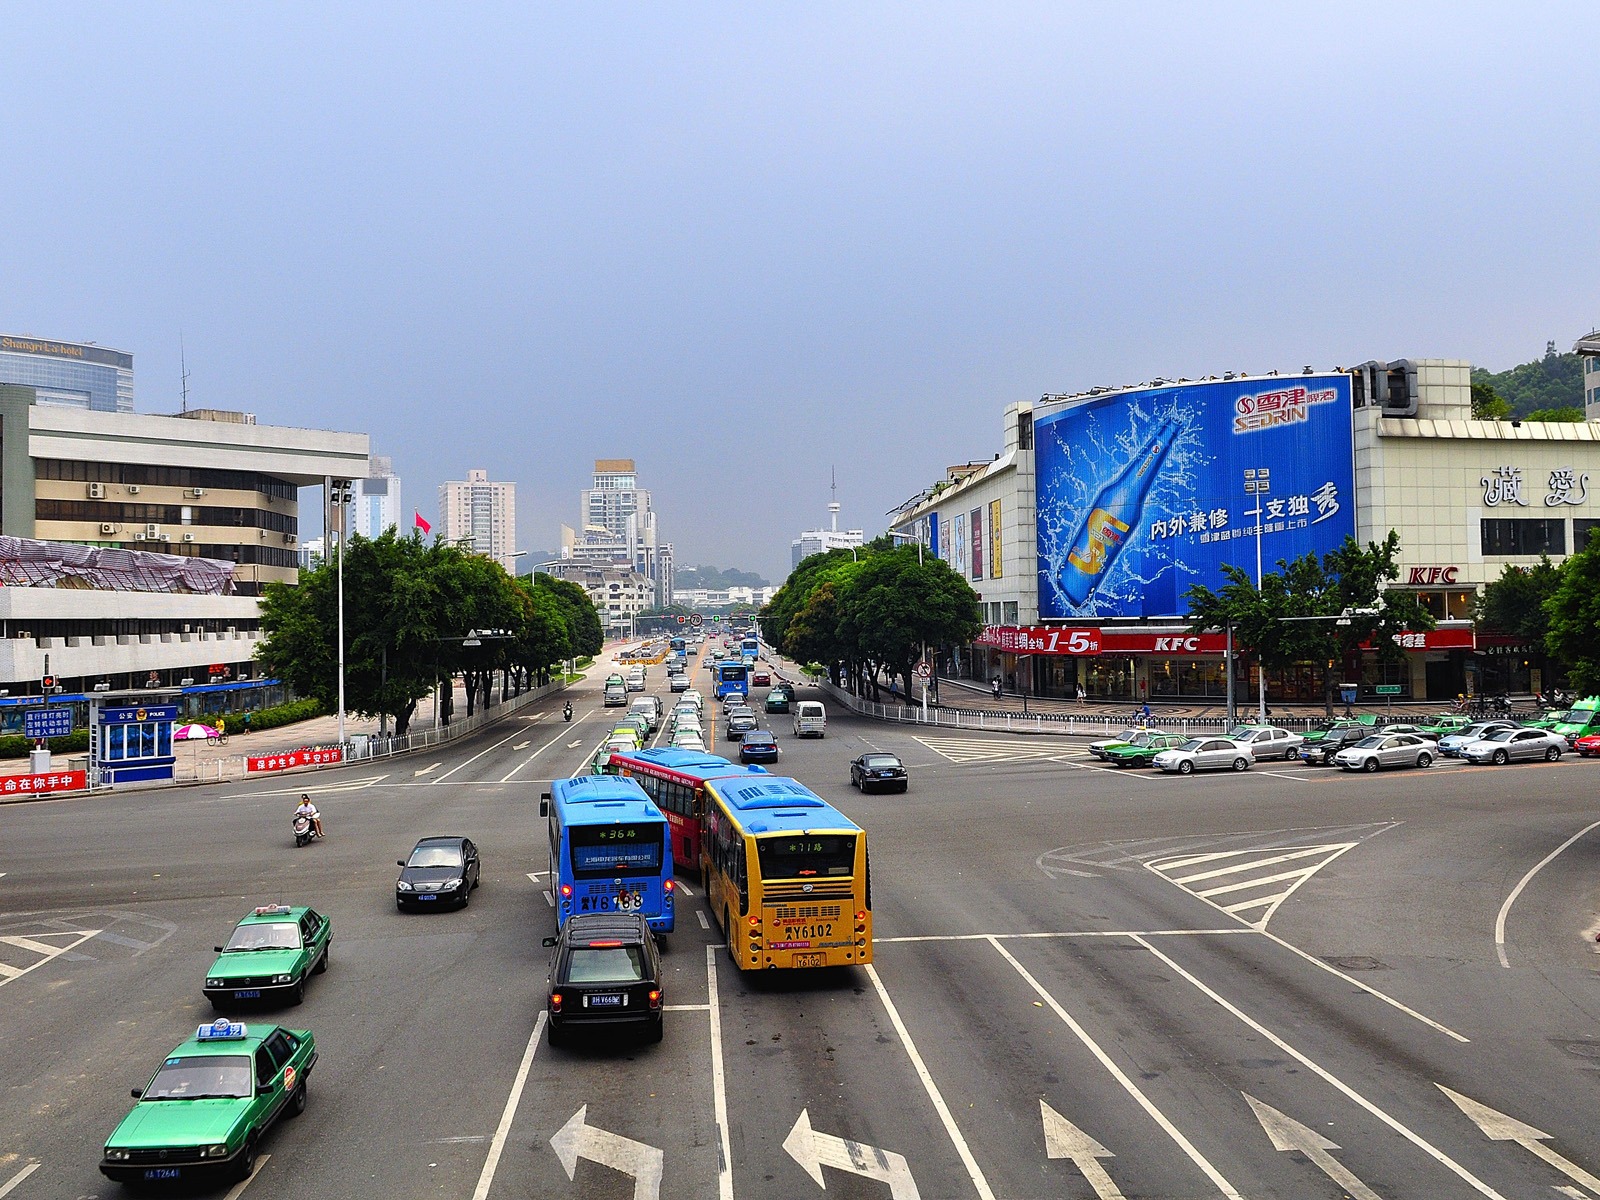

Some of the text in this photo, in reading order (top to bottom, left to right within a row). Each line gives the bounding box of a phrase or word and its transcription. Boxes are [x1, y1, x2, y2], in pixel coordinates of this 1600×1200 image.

[60, 345, 82, 356] hotel
[1235, 406, 1305, 432] SEDRIN
[1151, 481, 1340, 540] 内外兼修 一支独秀
[1409, 567, 1458, 584] KFC
[1154, 637, 1200, 651] KFC
[119, 712, 133, 720] 公安
[257, 752, 338, 770] 保护生命 平安出行
[794, 923, 832, 940] Y6102
[798, 958, 820, 967] Y6102
